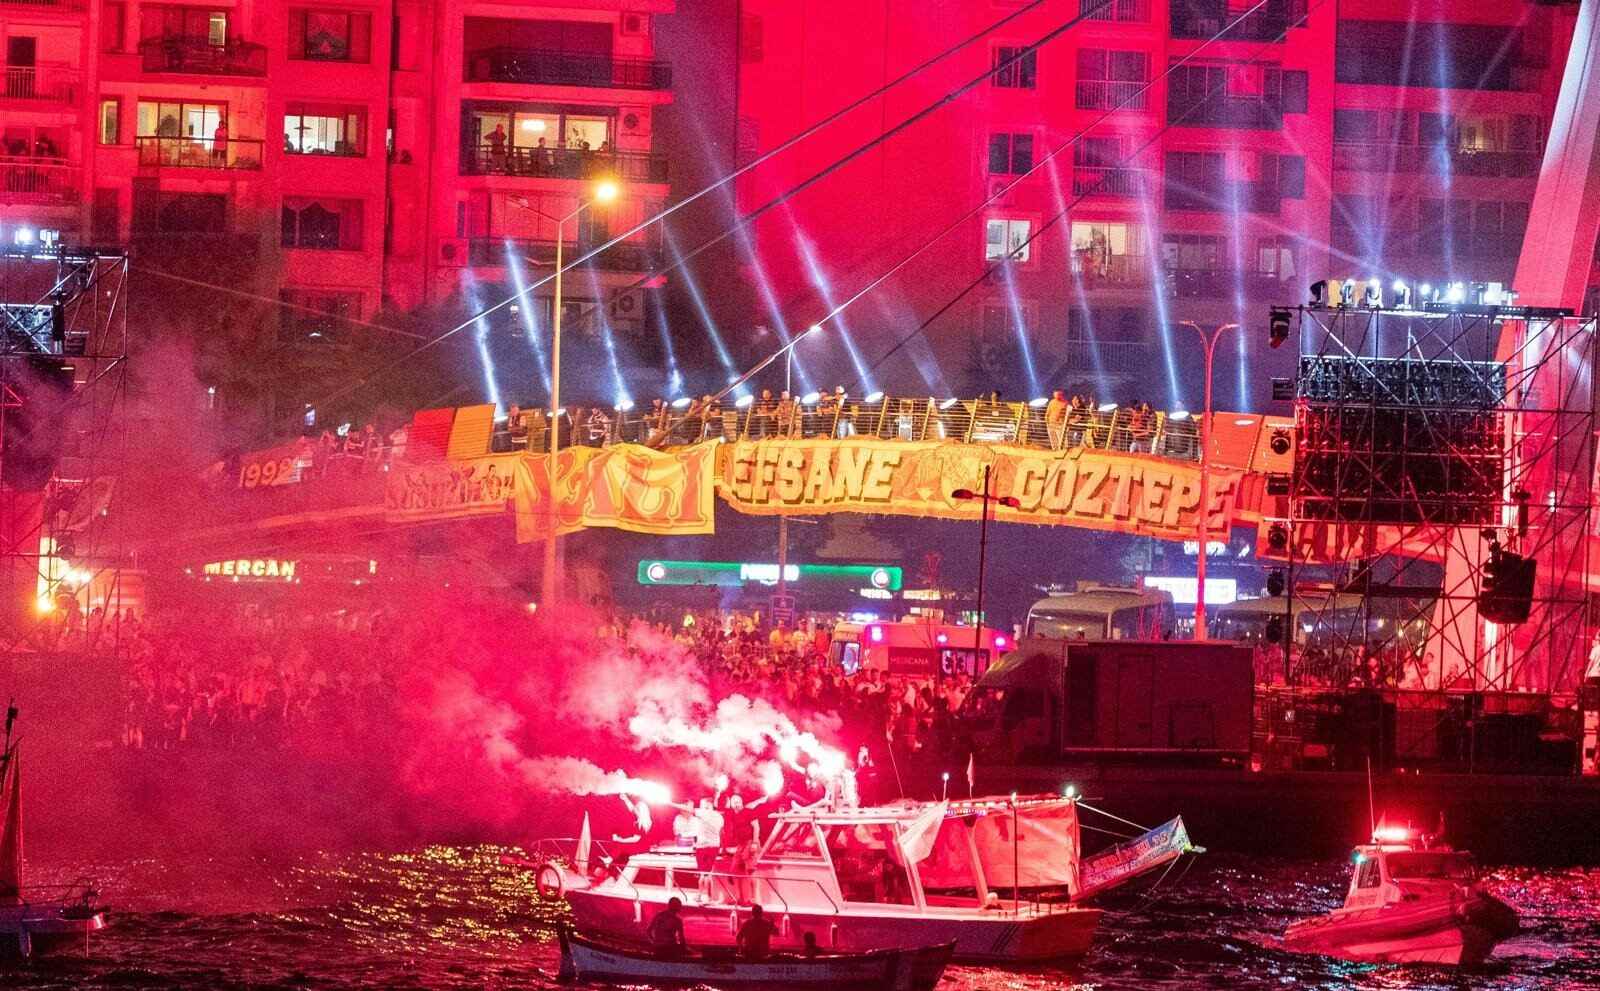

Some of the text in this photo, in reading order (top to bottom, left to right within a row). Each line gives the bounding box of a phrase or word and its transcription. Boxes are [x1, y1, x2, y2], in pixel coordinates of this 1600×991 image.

[730, 444, 1245, 534] EFSANE GÖZTEPE
[203, 559, 297, 577] MERCAN
